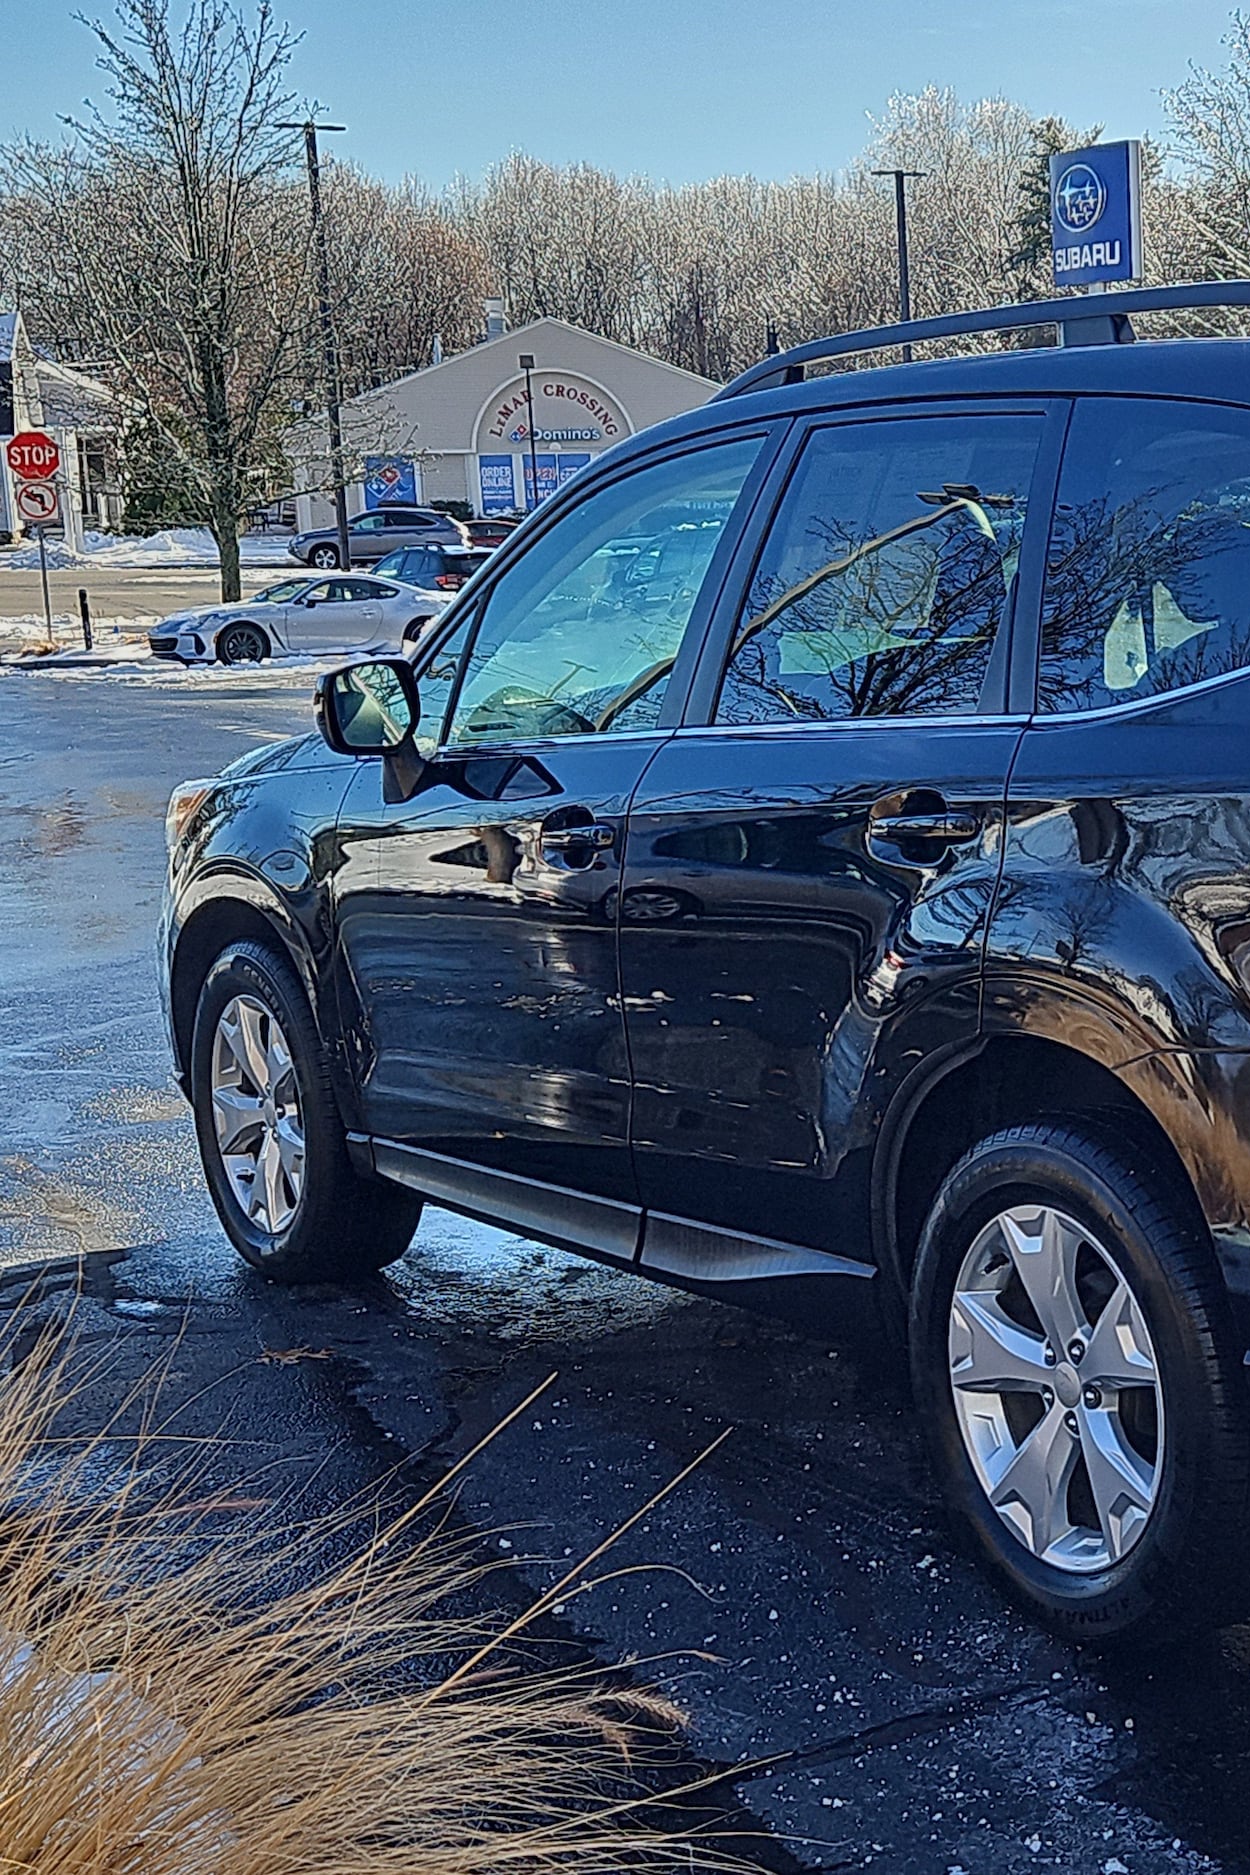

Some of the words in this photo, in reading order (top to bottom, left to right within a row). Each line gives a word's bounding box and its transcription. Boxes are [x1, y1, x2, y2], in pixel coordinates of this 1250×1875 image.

[1055, 240, 1120, 272] SUBARU
[543, 384, 618, 436] CROSSING
[532, 426, 600, 441] Domino's
[10, 446, 56, 466] STOP
[481, 466, 512, 478] ORDER
[482, 477, 512, 488] ONLINE
